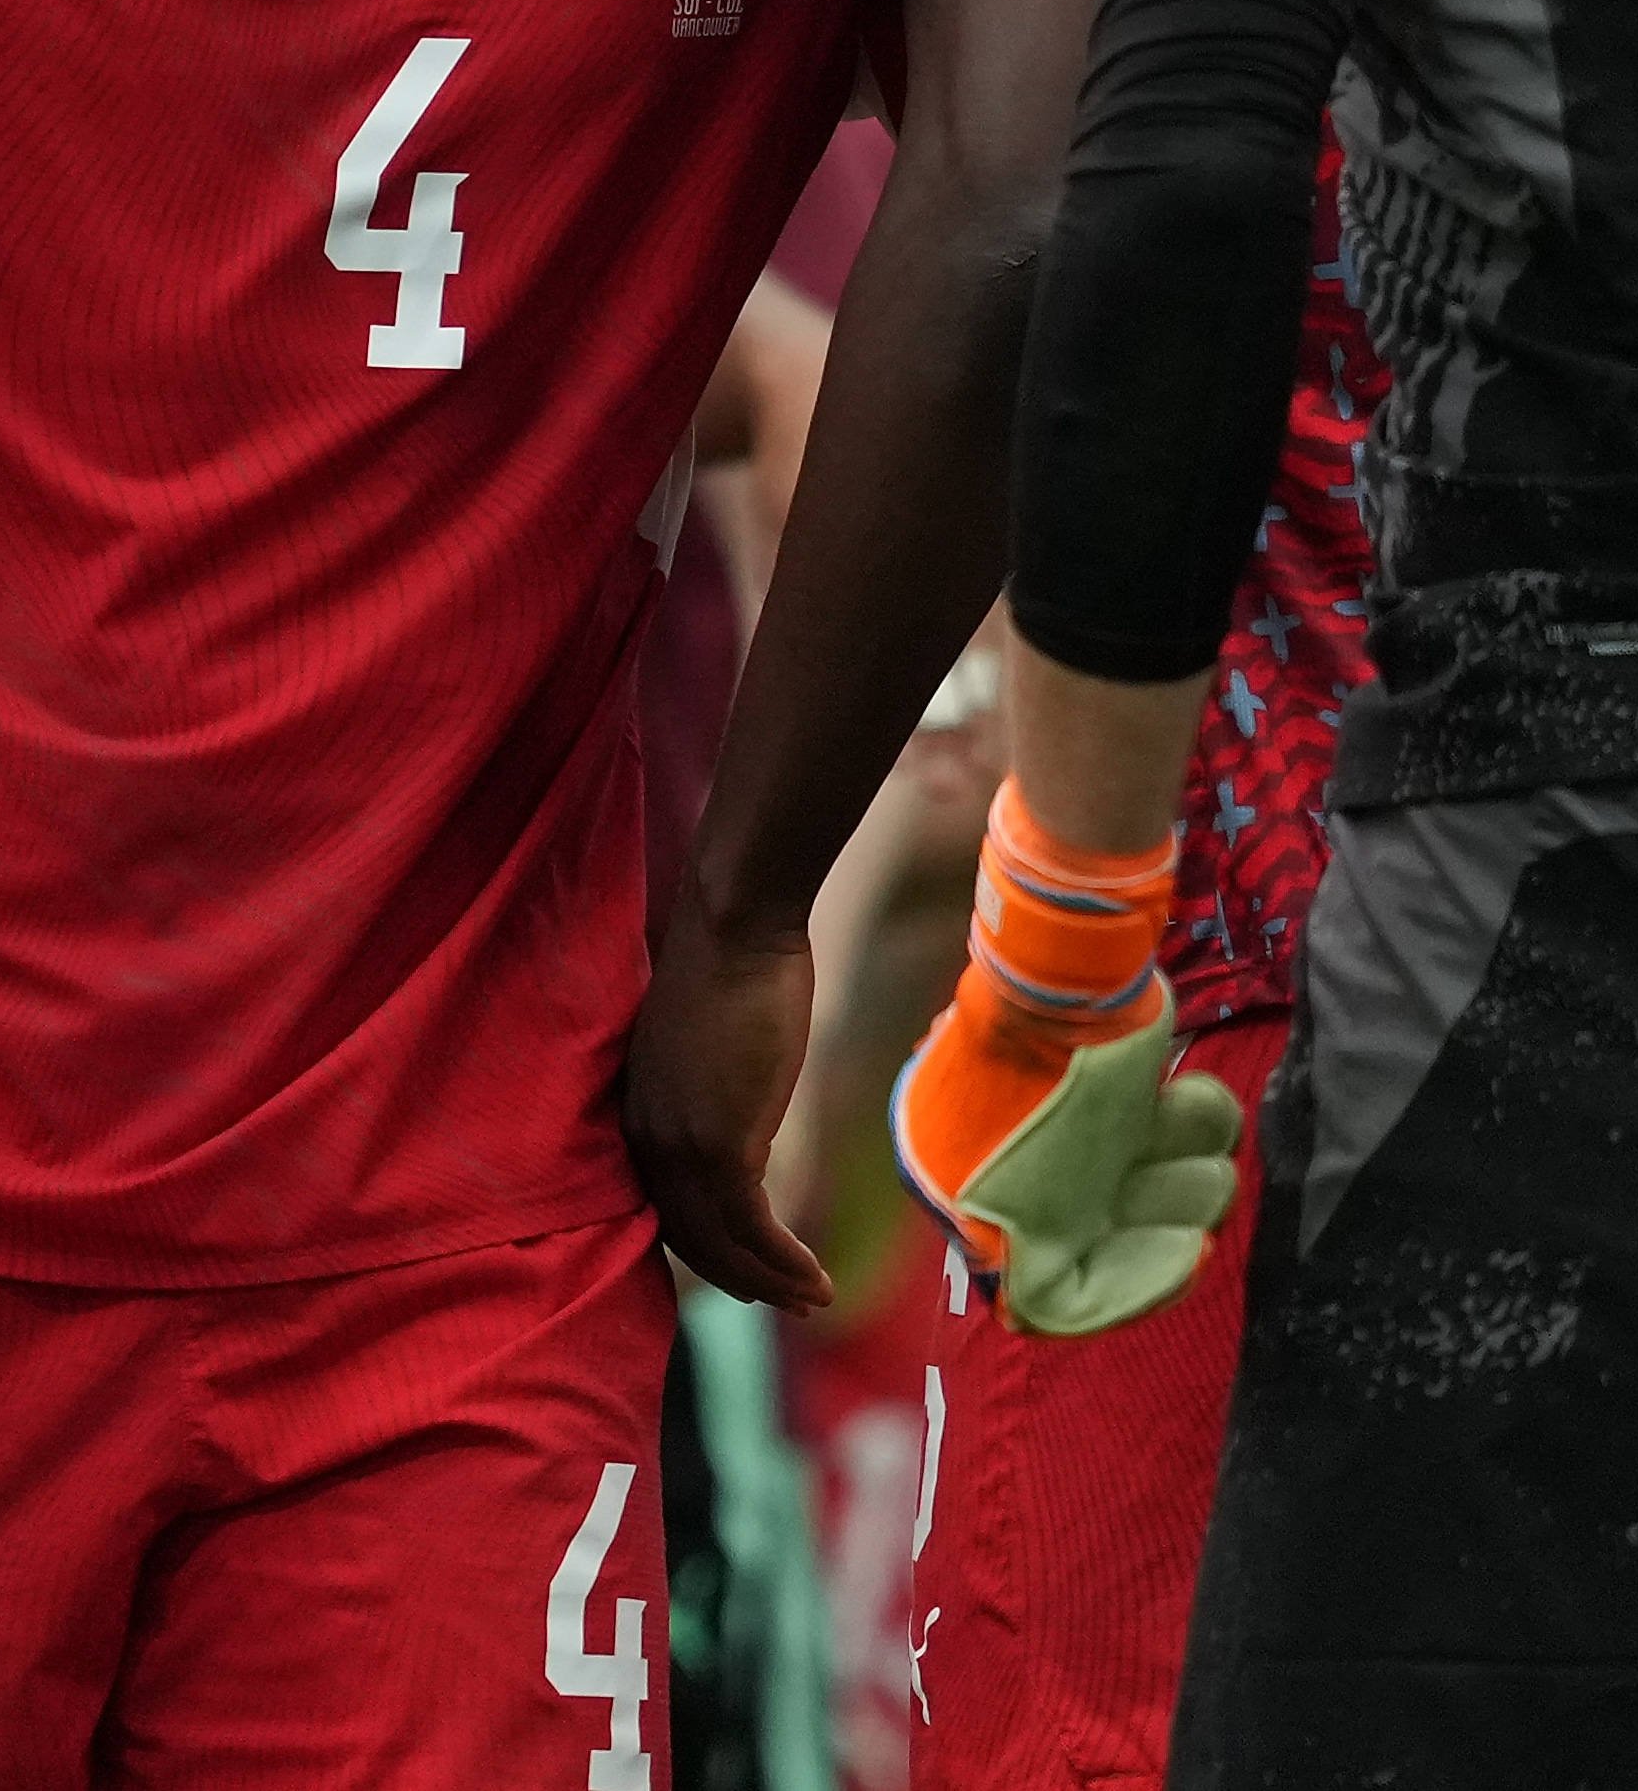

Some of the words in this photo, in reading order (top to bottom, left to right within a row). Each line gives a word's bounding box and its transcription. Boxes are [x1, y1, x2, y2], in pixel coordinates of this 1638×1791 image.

[671, 16, 740, 38] VANCOUVER
[324, 37, 472, 370] 4
[544, 1462, 651, 1791] 4
